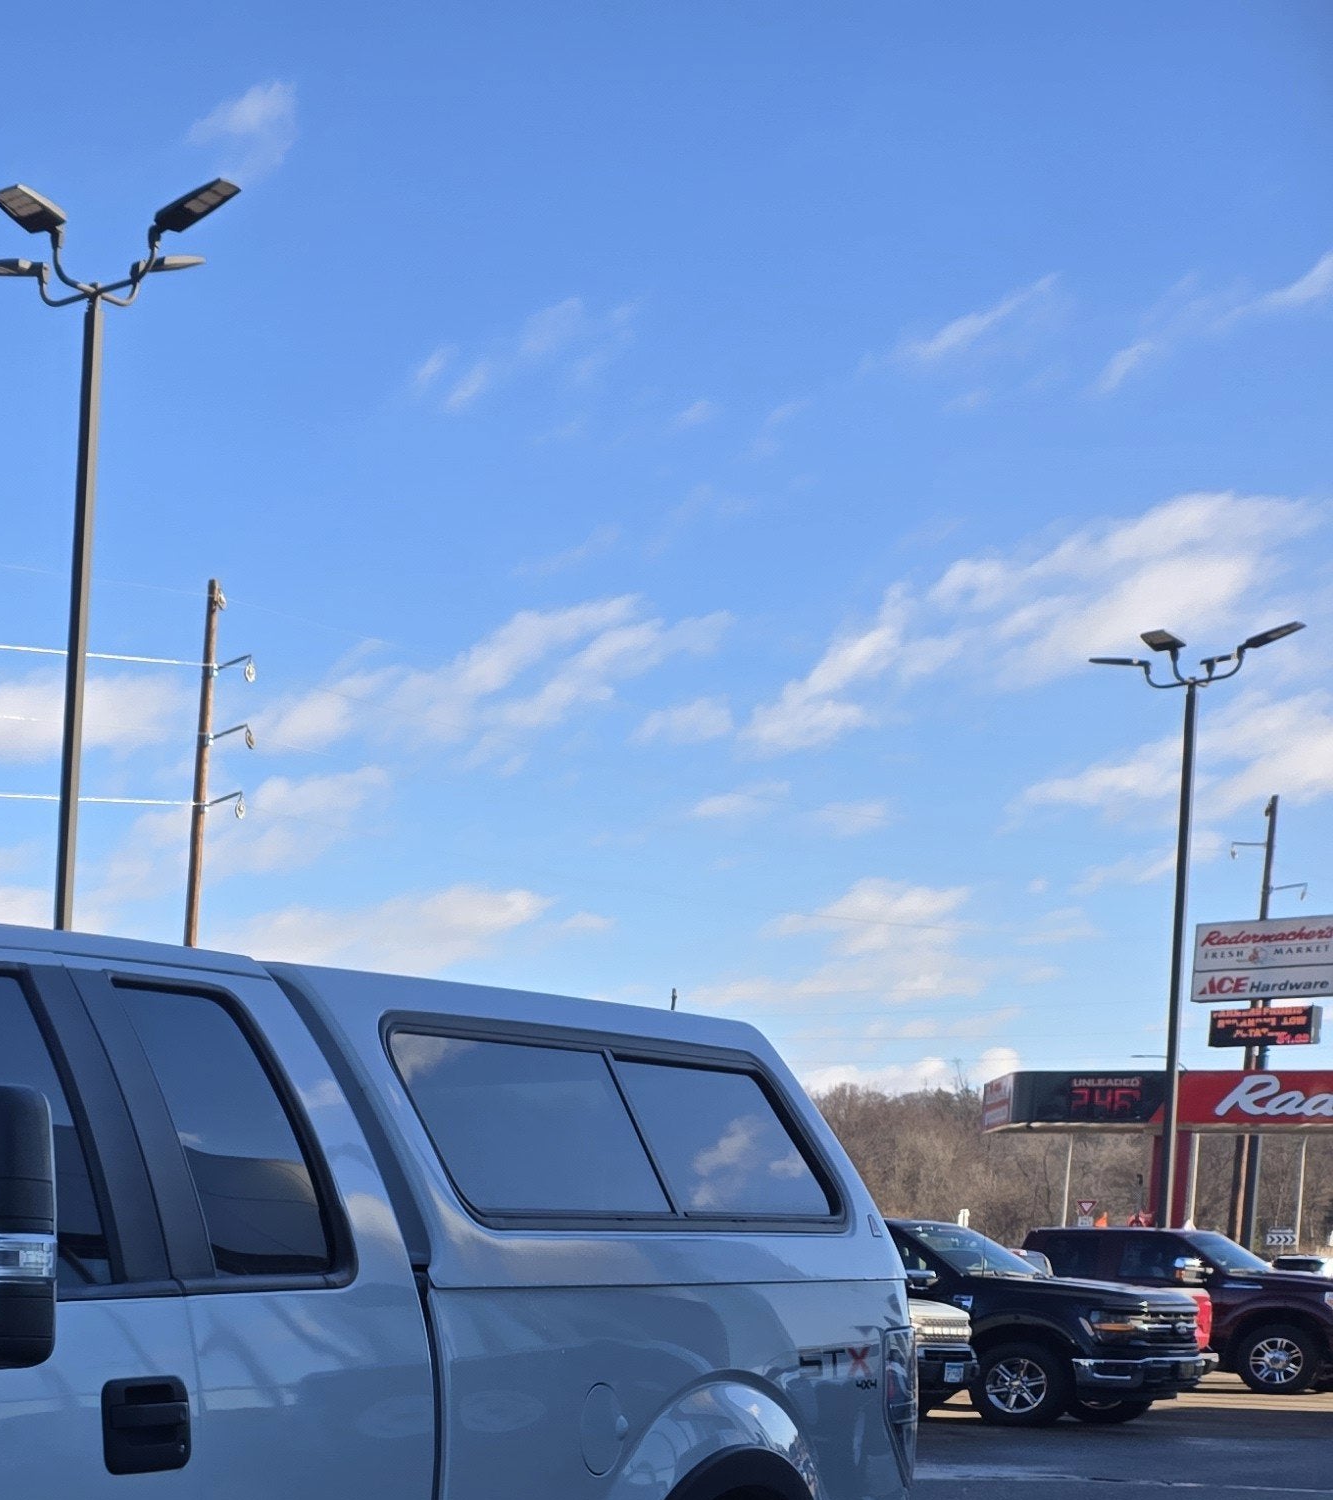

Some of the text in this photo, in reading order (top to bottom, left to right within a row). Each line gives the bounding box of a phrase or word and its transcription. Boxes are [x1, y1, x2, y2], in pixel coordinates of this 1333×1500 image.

[1204, 944, 1330, 960] FRESH MARKET
[1198, 976, 1330, 995] ACE Hardware
[1073, 1078, 1140, 1088] UNLEADED
